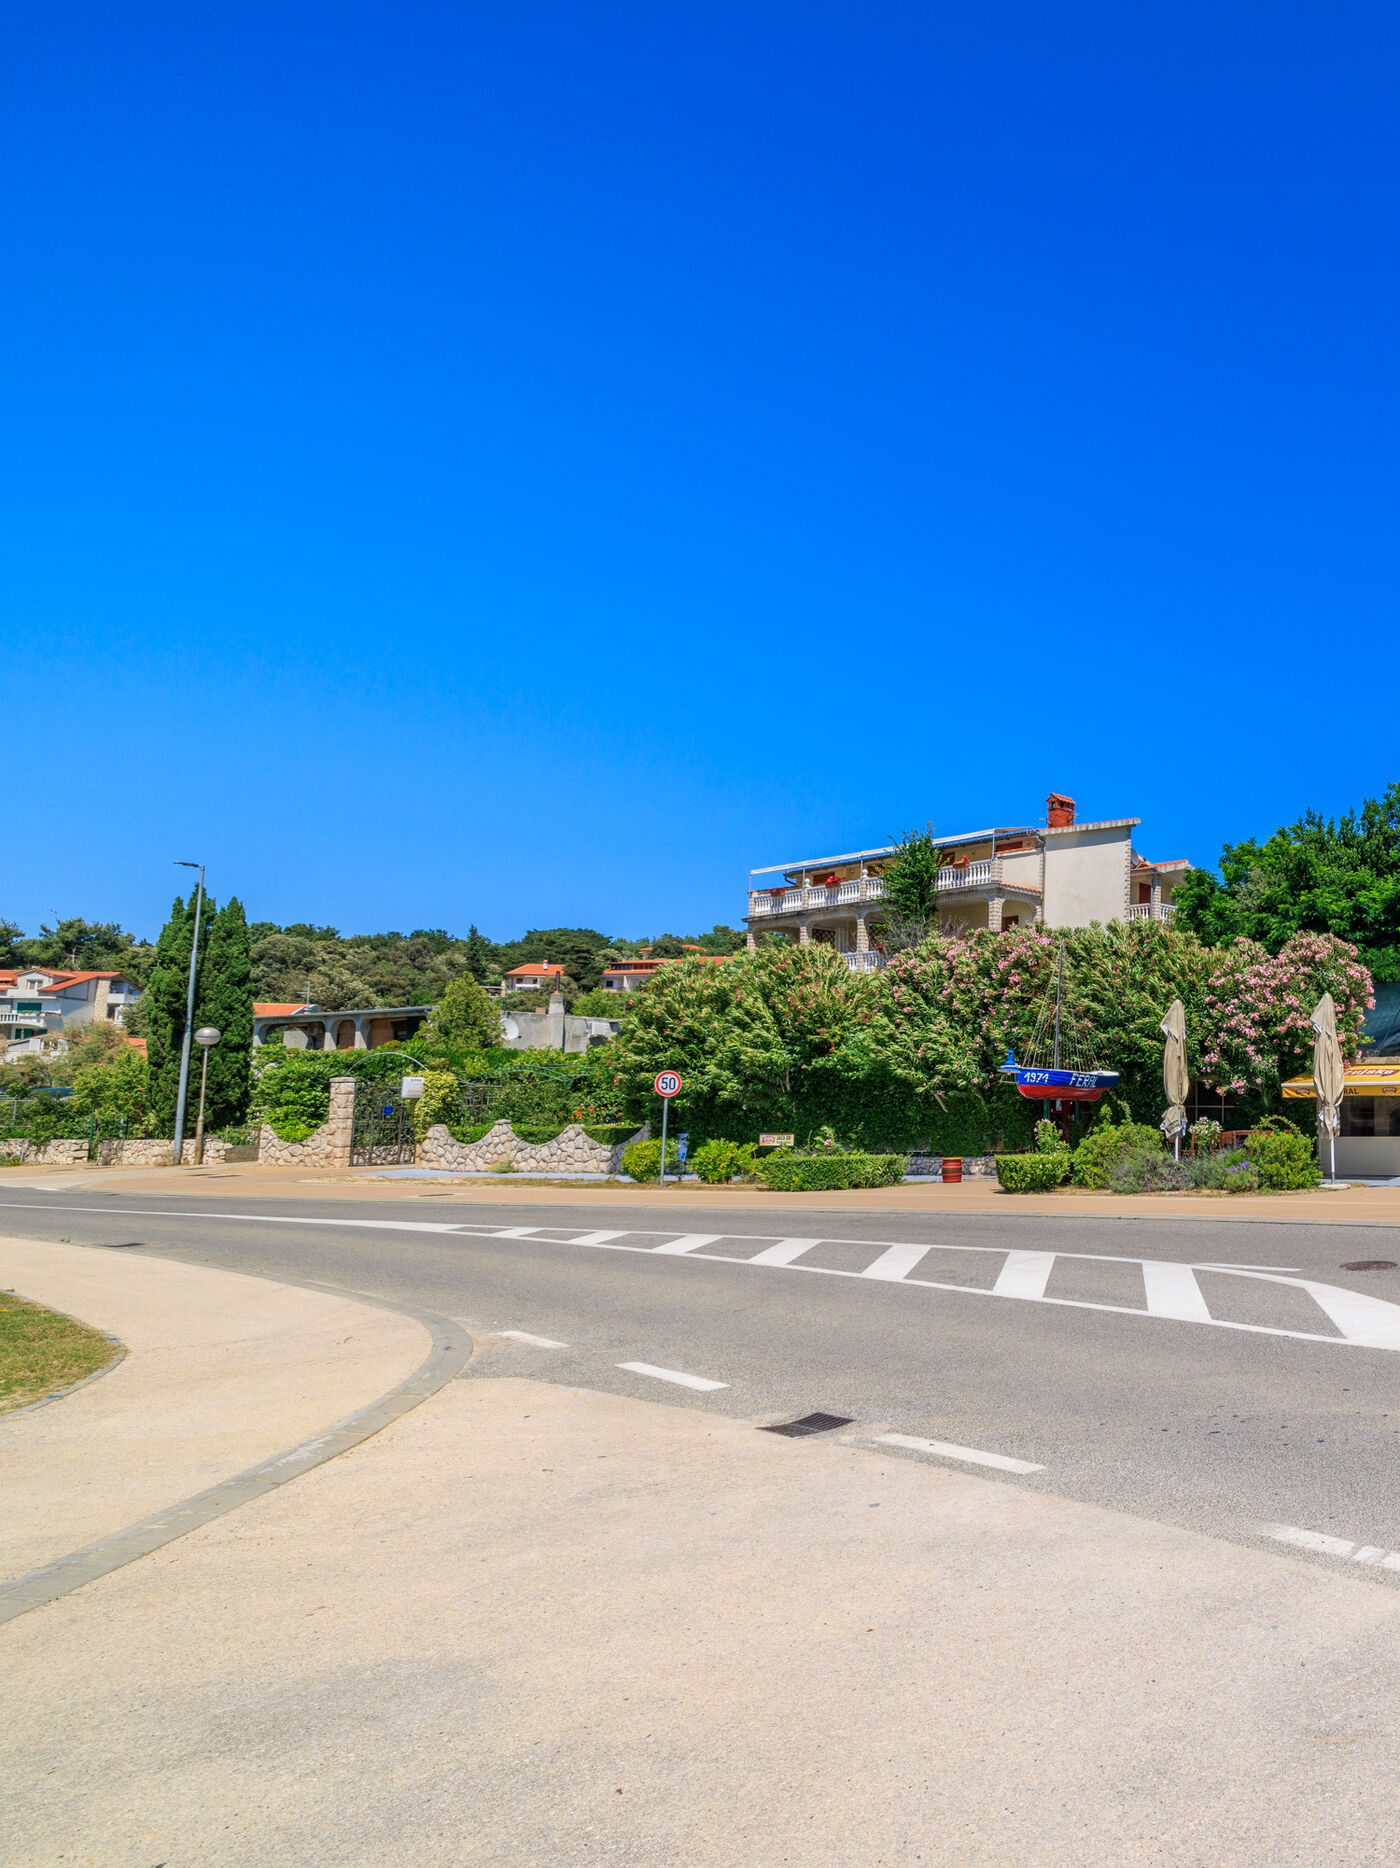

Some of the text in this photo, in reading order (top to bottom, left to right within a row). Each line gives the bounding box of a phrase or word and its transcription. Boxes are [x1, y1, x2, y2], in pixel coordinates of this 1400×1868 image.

[661, 1077, 676, 1090] 50
[1024, 1072, 1049, 1083] 1971
[1069, 1073, 1098, 1088] FERAL
